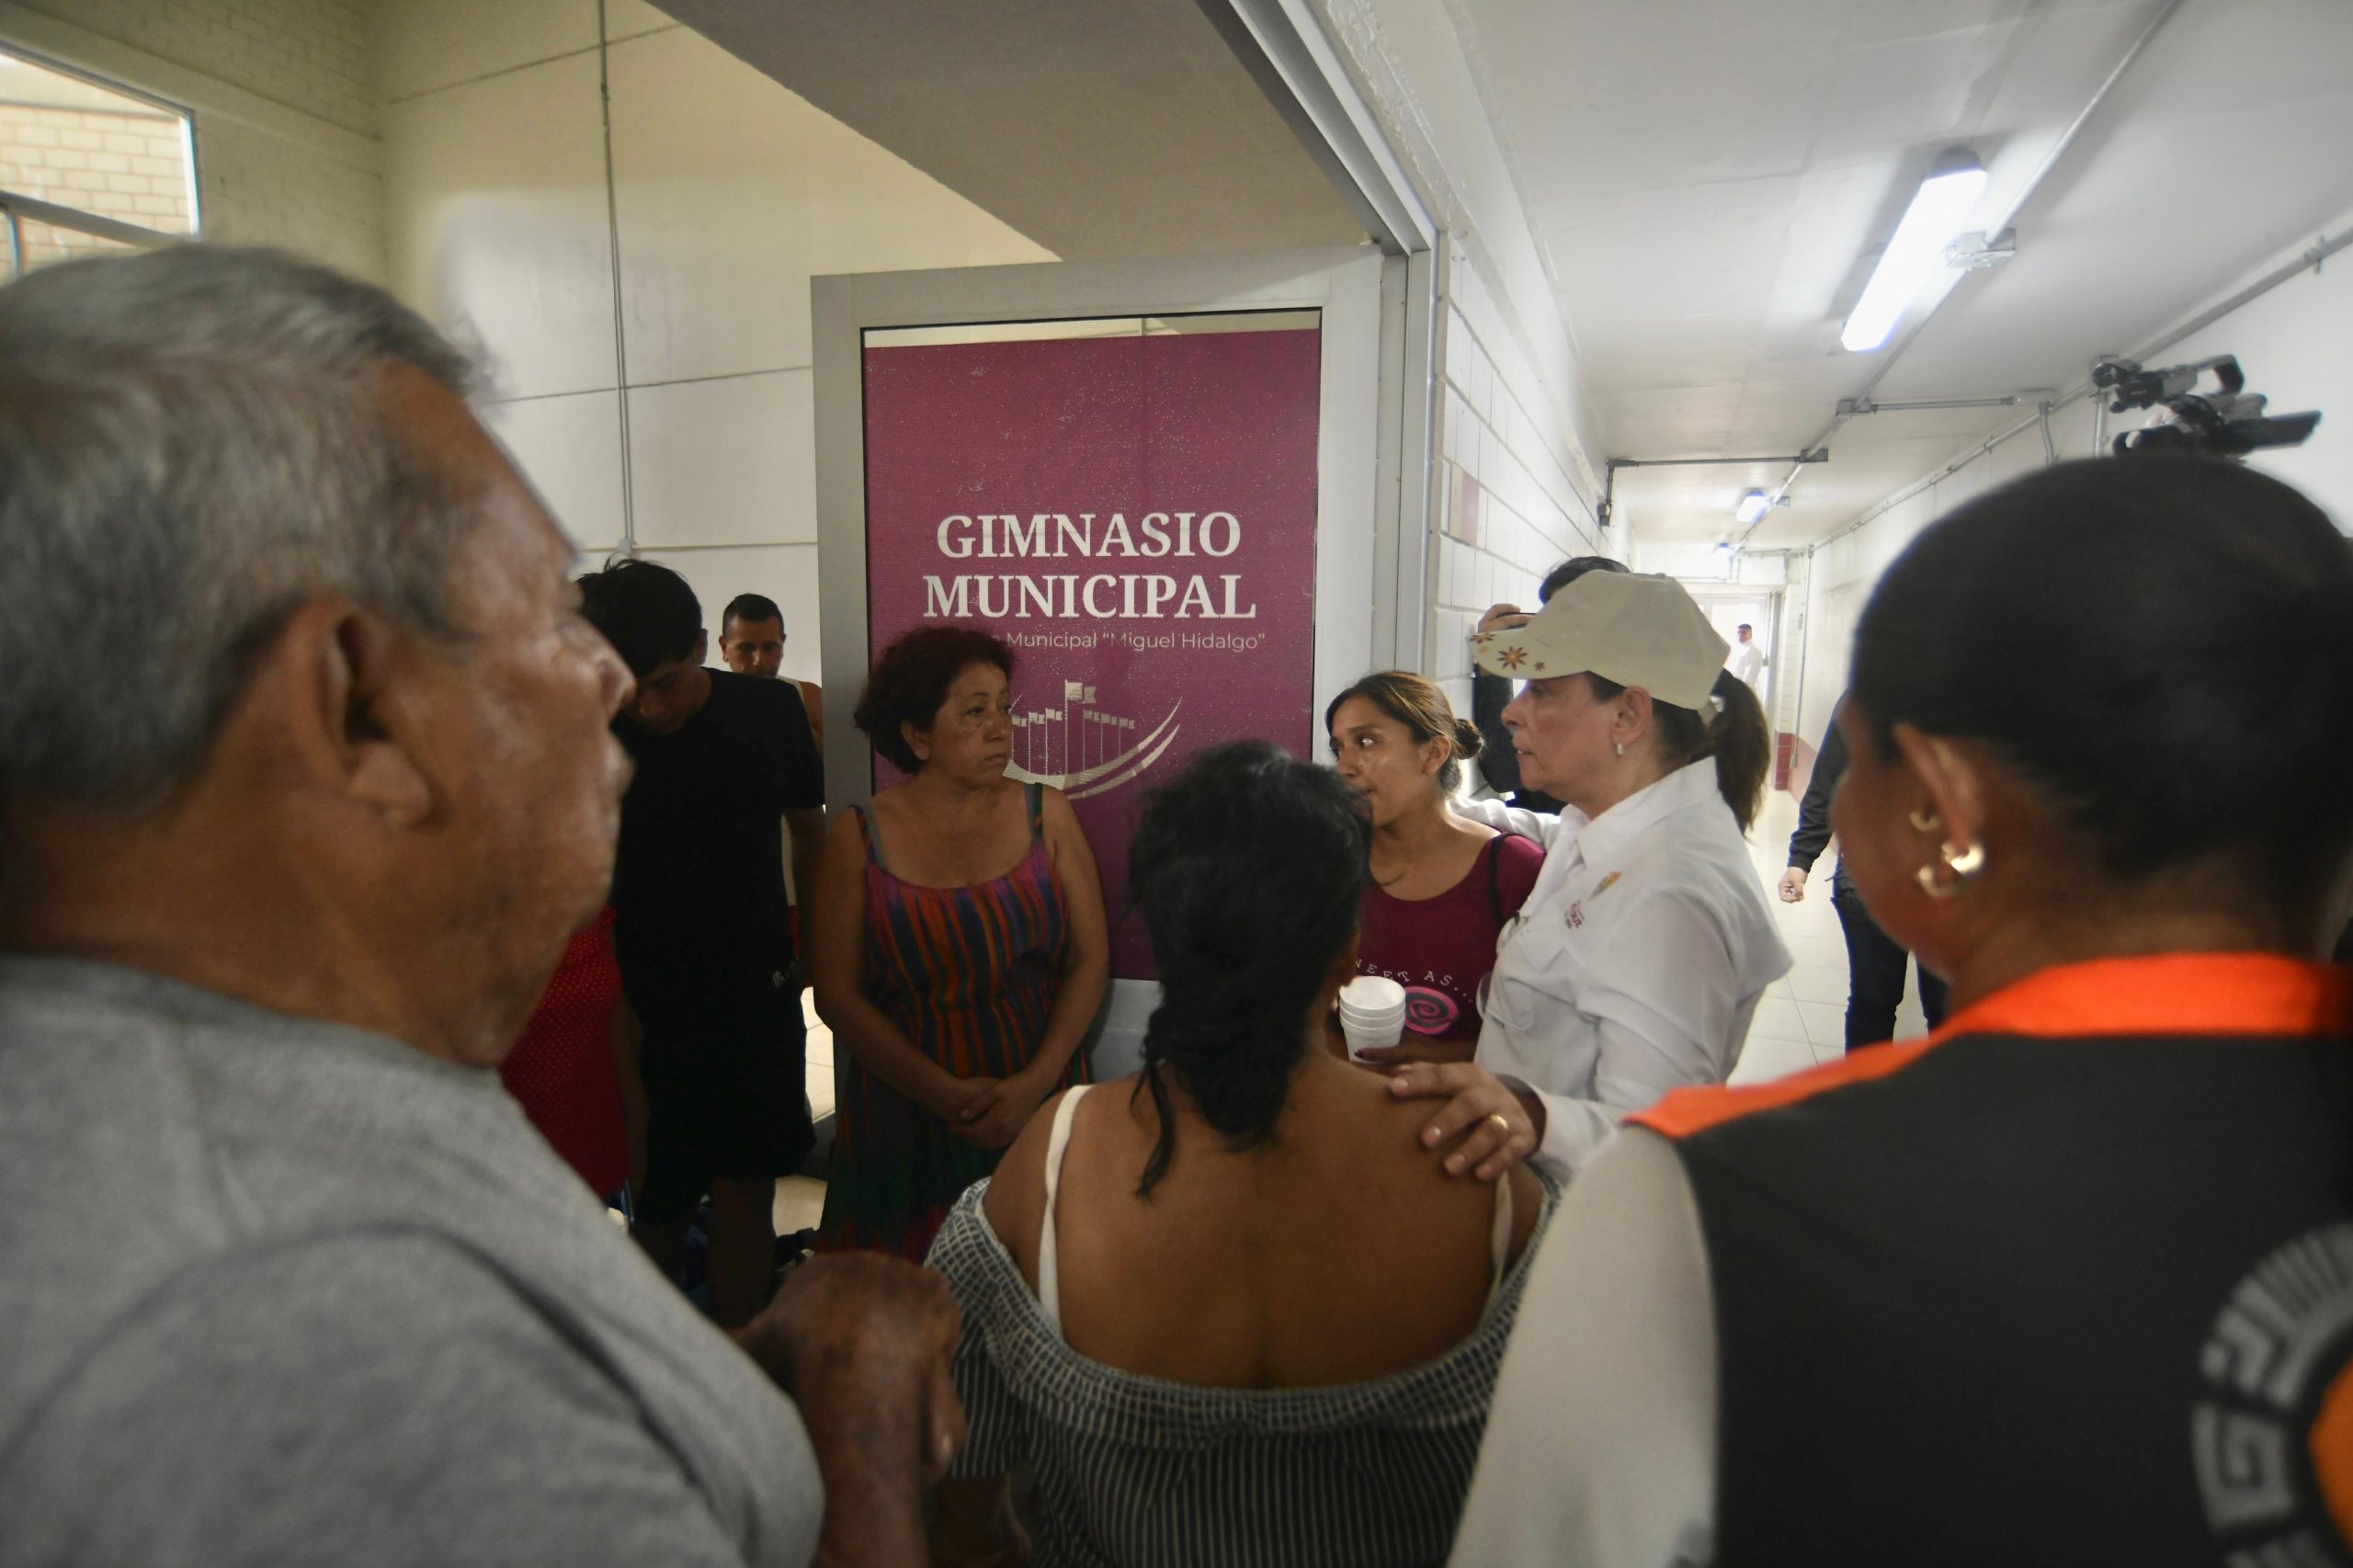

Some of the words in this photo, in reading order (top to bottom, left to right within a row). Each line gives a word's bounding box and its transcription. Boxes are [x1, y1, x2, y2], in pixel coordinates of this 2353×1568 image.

[937, 512, 1242, 558] GIMNASIO
[923, 574, 1256, 619] MUNICIPAL
[1006, 631, 1097, 651] Municipal
[1102, 631, 1175, 652] “Miguel
[1181, 631, 1266, 653] Hidalgo”
